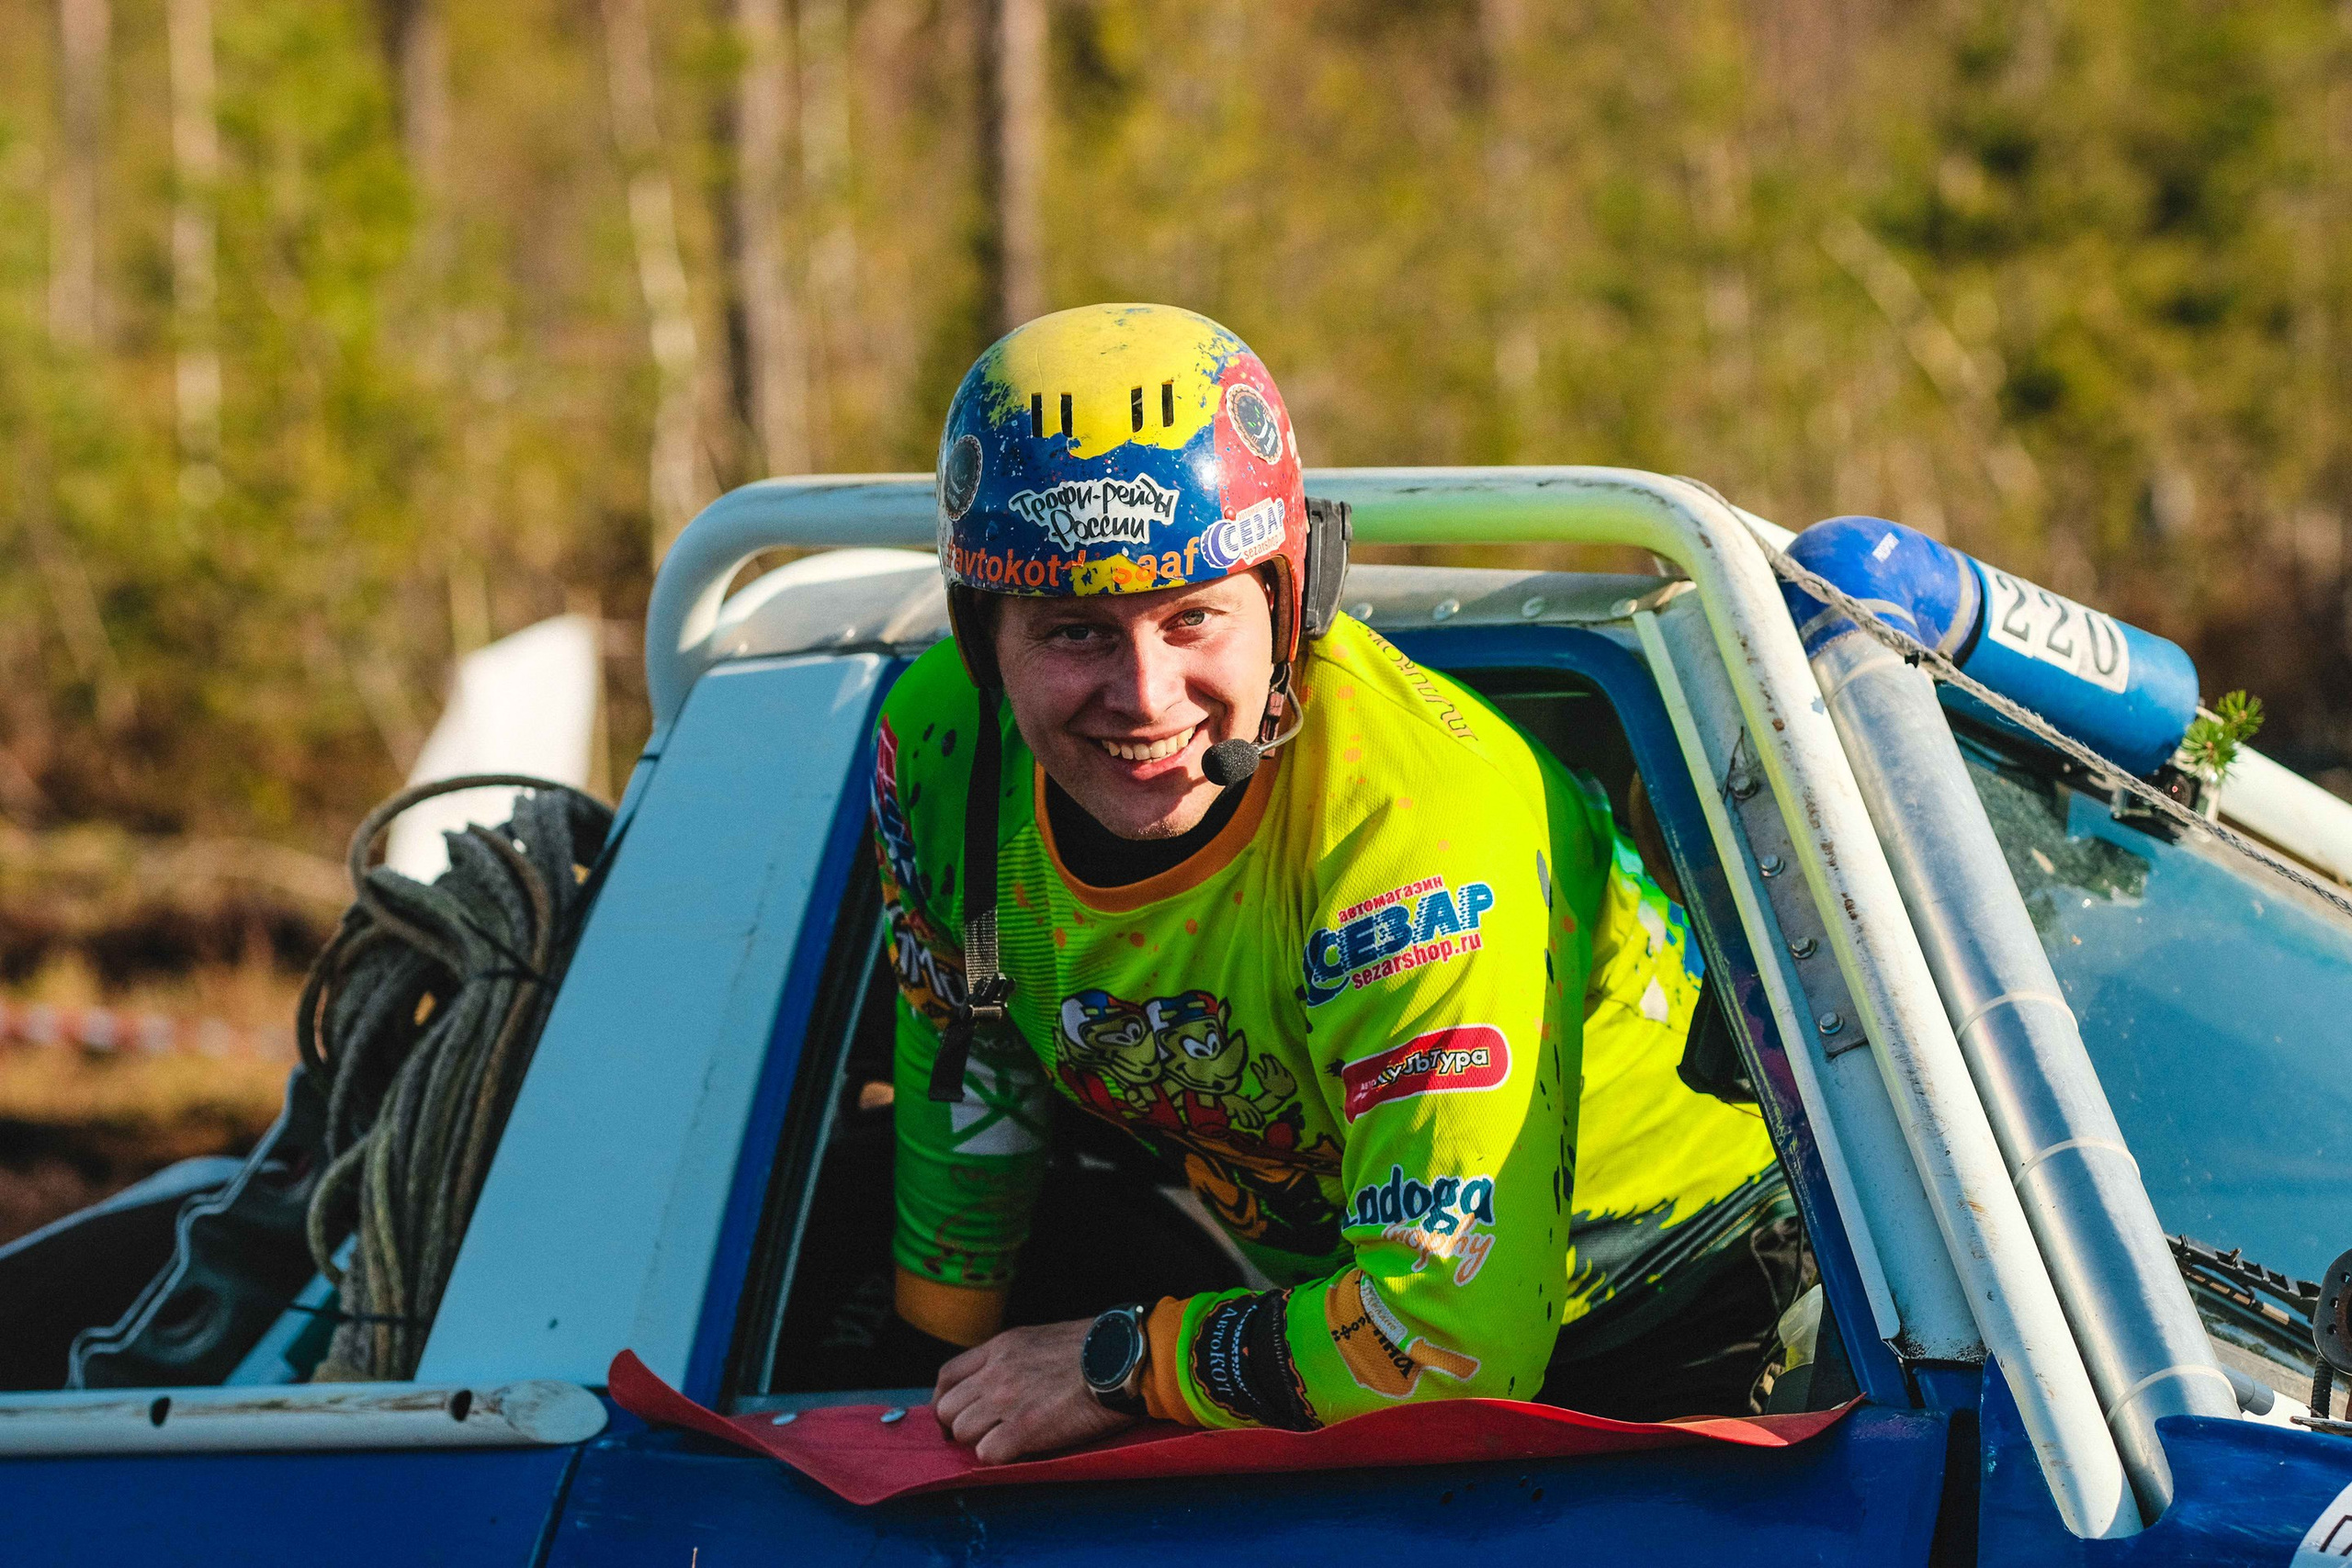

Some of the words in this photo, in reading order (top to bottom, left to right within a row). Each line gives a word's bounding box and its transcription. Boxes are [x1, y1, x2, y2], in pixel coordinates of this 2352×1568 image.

[1050, 509, 1146, 547] России
[1996, 574, 2120, 676] 220
[1338, 875, 1443, 923] автомагазин
[1351, 933, 1482, 990] sezarshop.ru
[1342, 1165, 1494, 1234] Ladoga
